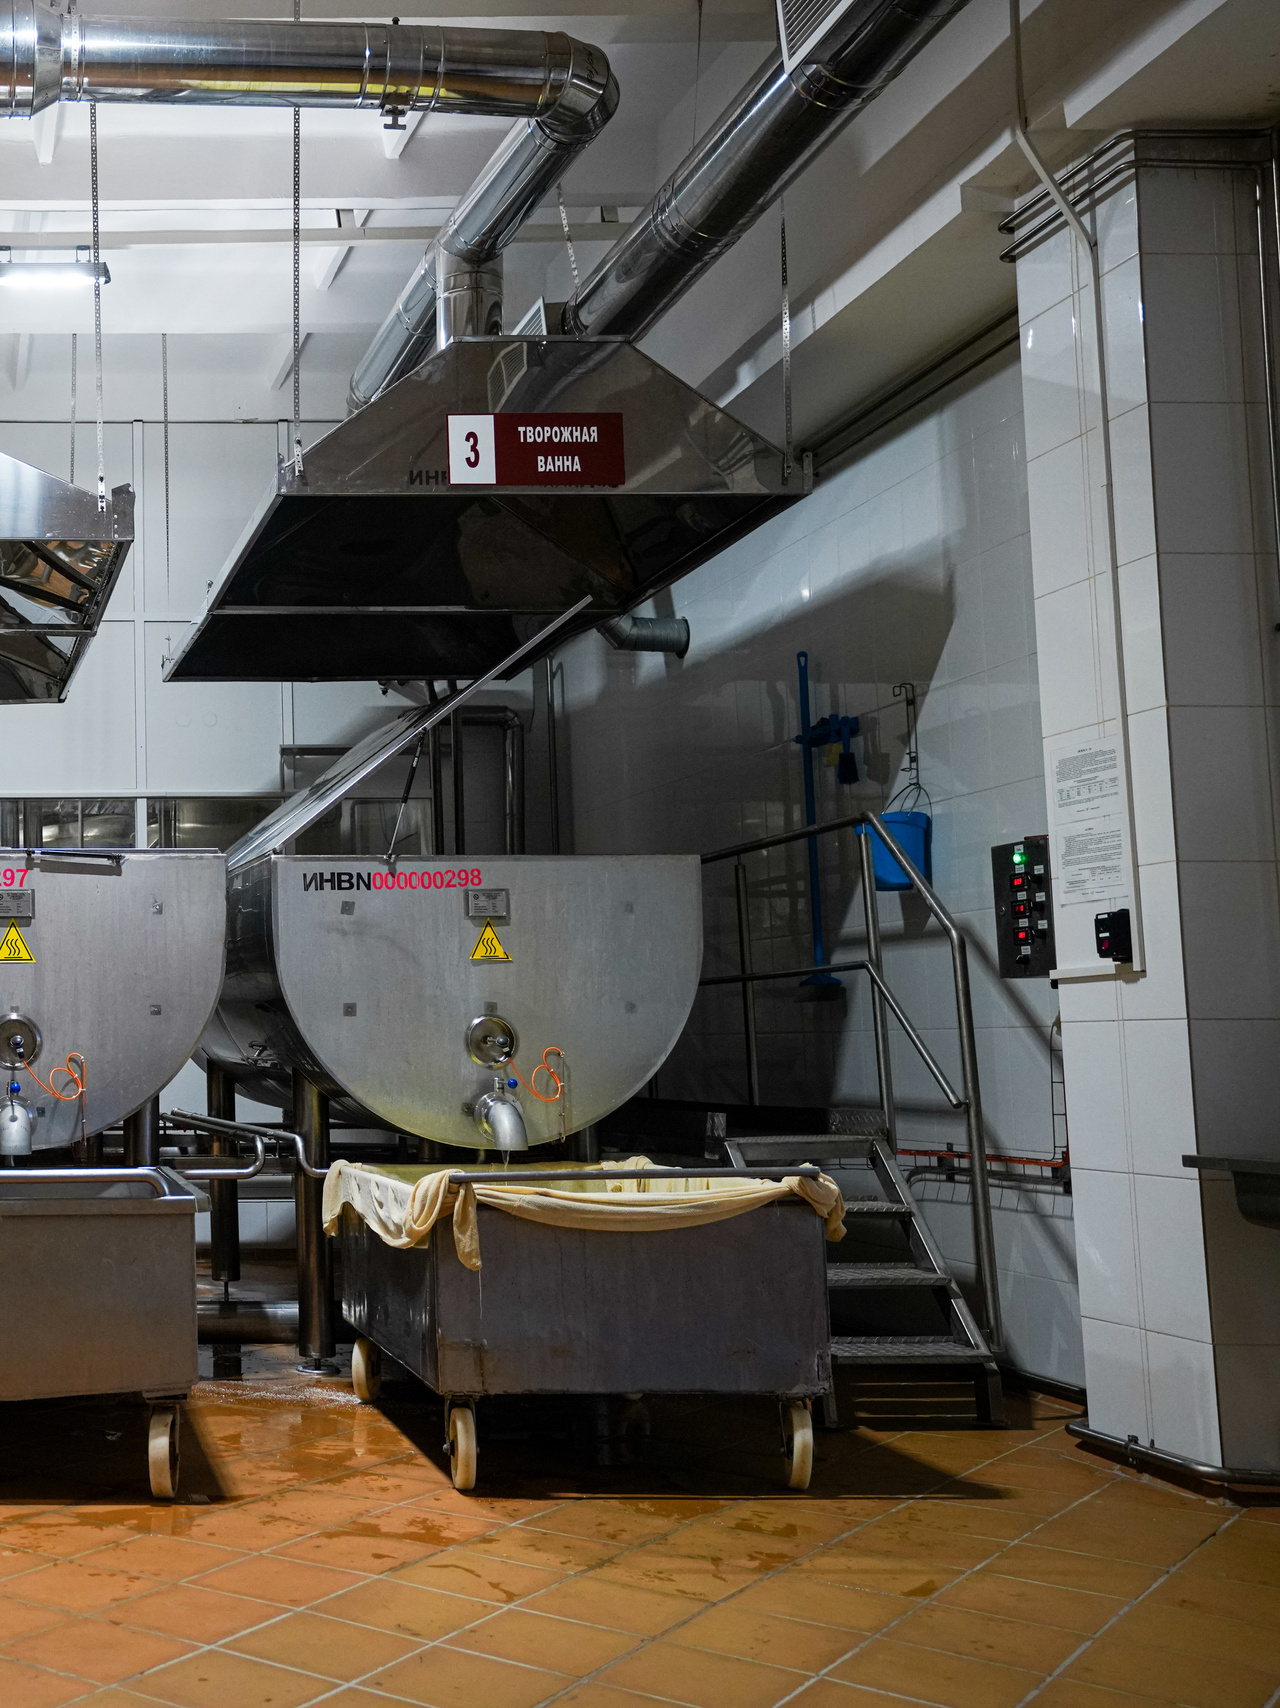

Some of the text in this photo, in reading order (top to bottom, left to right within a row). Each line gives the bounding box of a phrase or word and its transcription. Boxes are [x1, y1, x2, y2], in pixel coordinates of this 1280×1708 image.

[517, 426, 598, 443] ТВОРОЖНАЯ
[464, 431, 480, 469] 3
[537, 455, 582, 472] ВАННА
